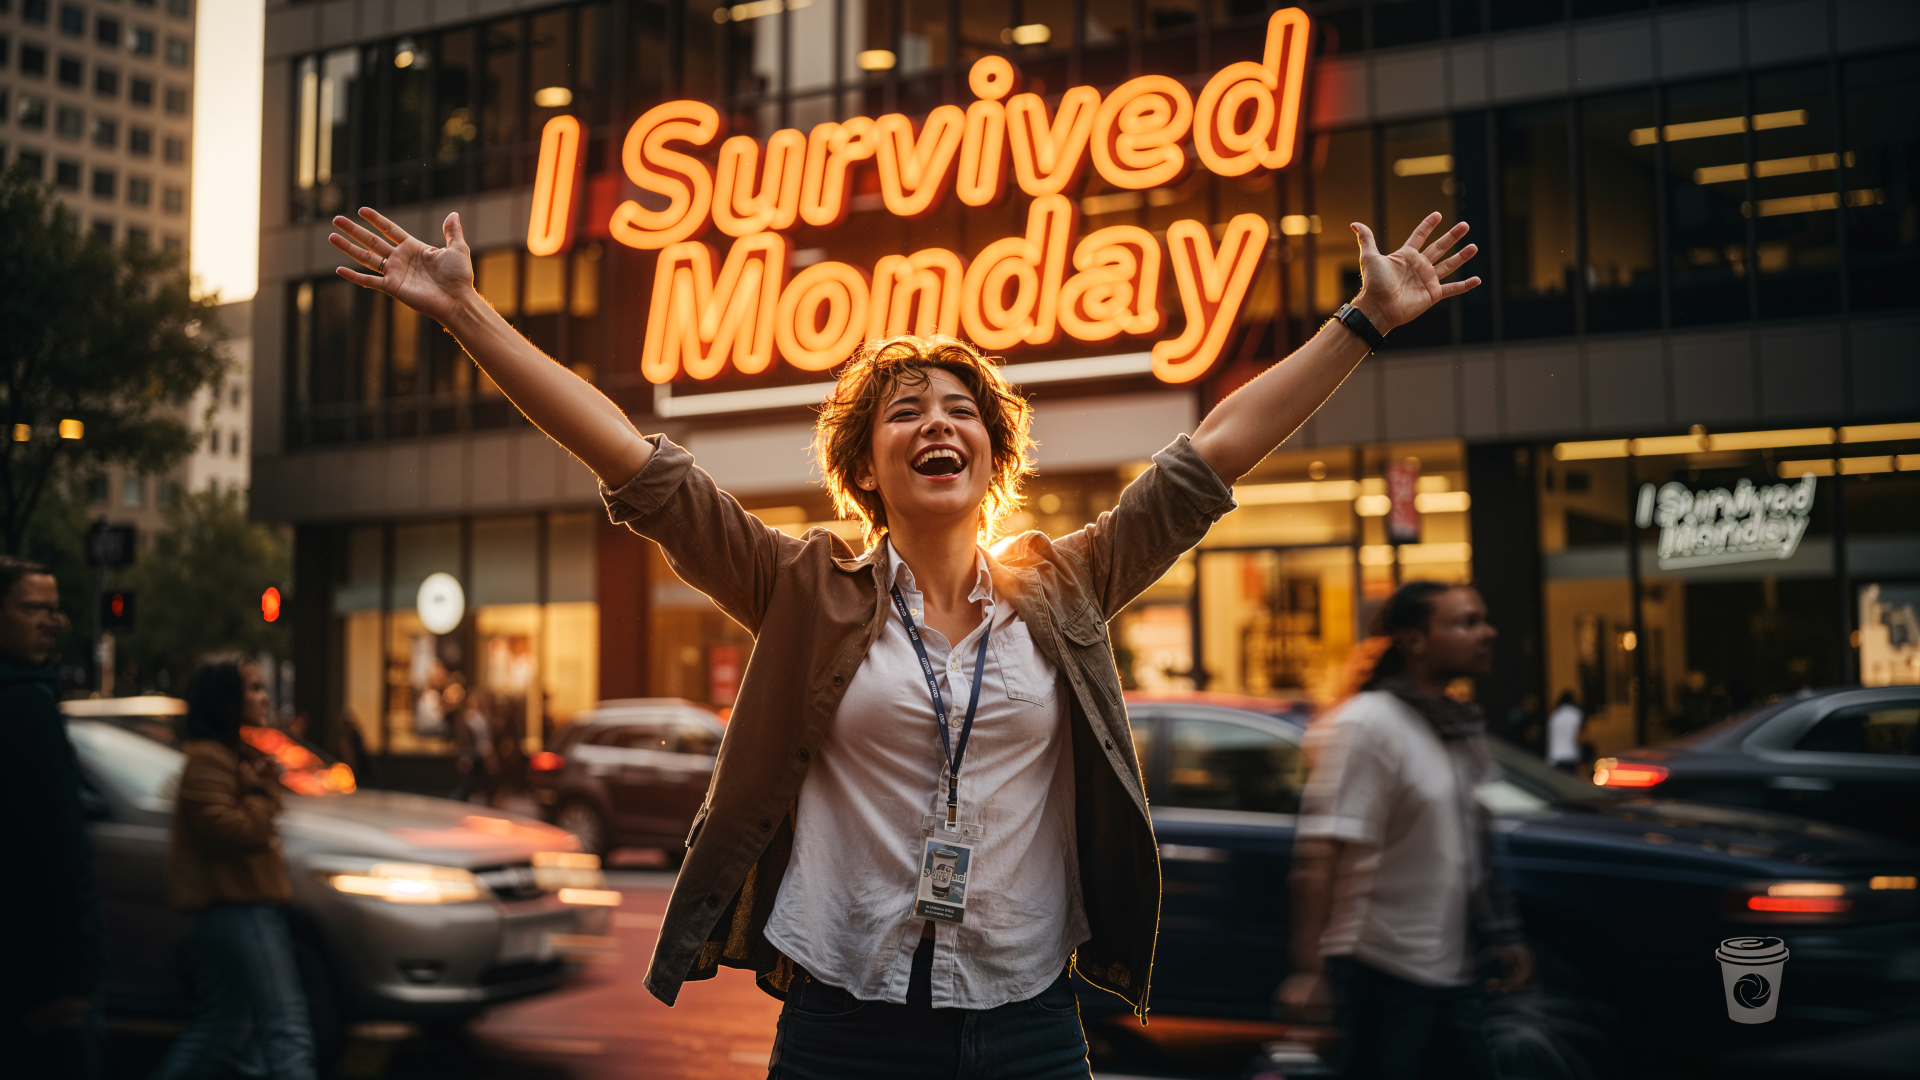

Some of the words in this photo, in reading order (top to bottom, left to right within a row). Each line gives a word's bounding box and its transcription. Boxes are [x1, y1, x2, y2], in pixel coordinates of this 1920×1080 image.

[527, 115, 580, 256] I
[609, 8, 1310, 250] Survived
[641, 195, 1268, 384] Monday
